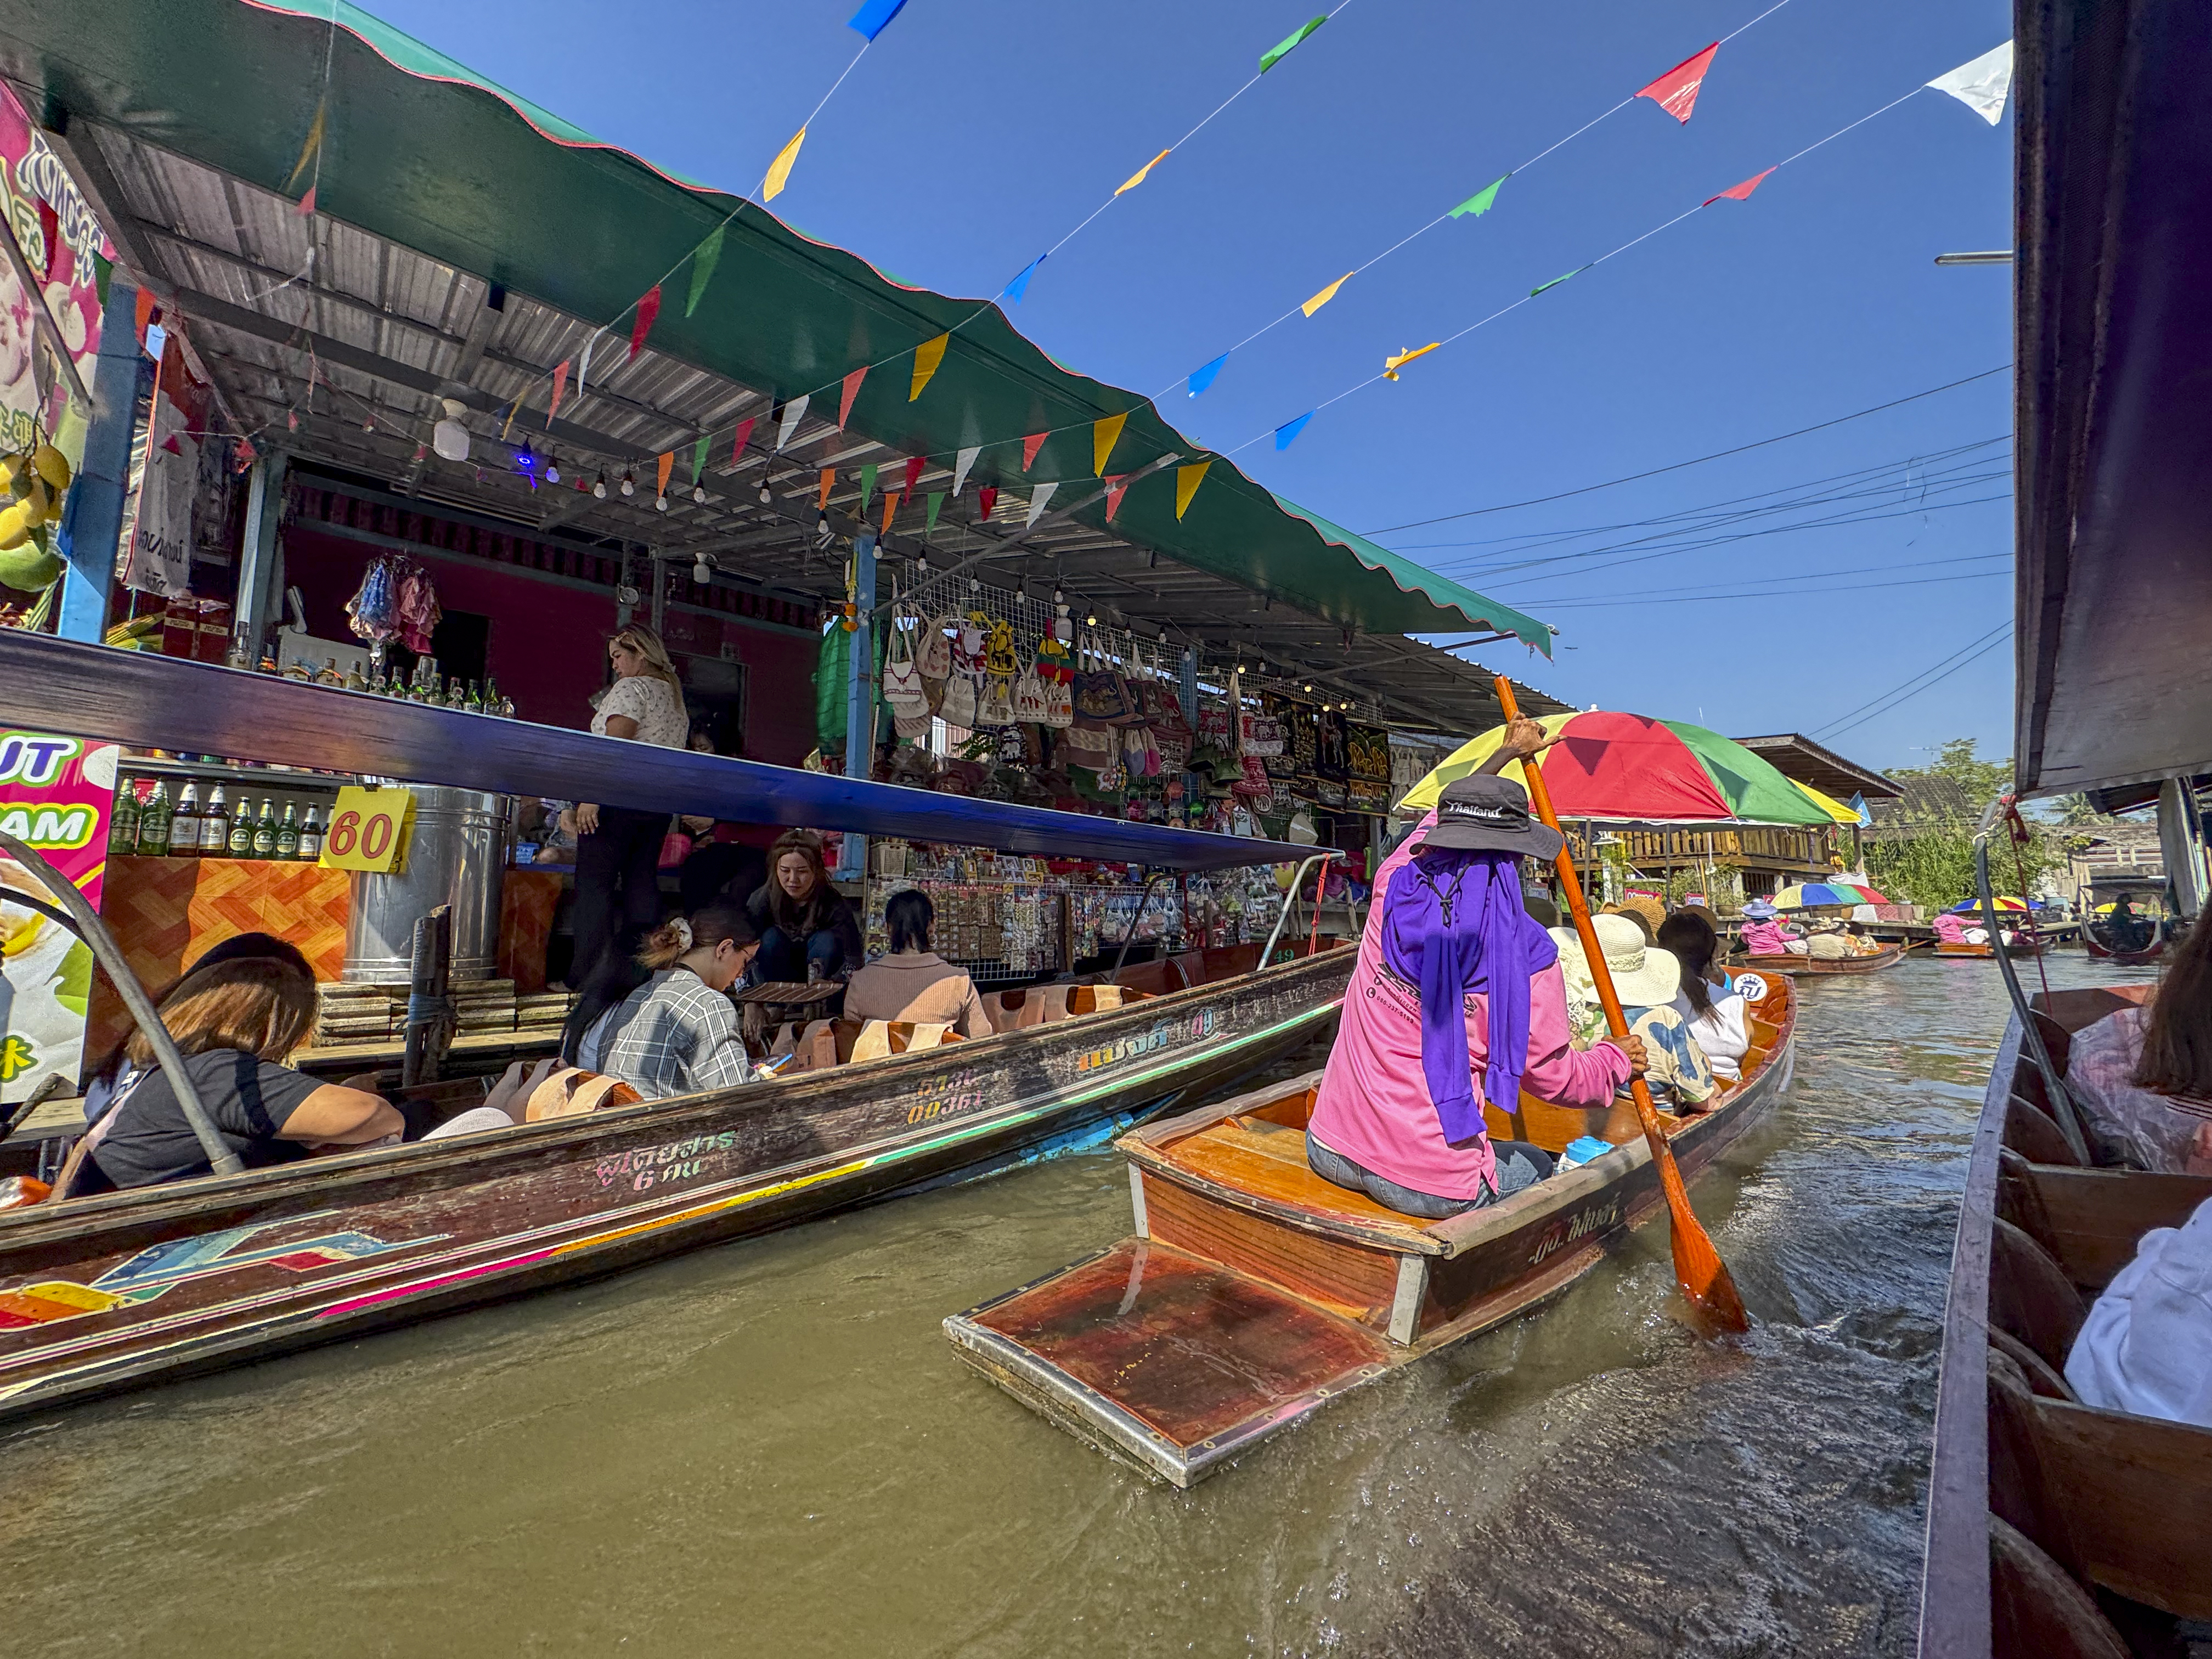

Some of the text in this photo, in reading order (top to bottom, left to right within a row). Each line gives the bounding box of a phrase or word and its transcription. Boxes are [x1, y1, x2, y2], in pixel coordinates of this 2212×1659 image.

[1445, 800, 1503, 819] Thailand
[330, 811, 392, 859] 60
[1274, 949, 1294, 963] 49
